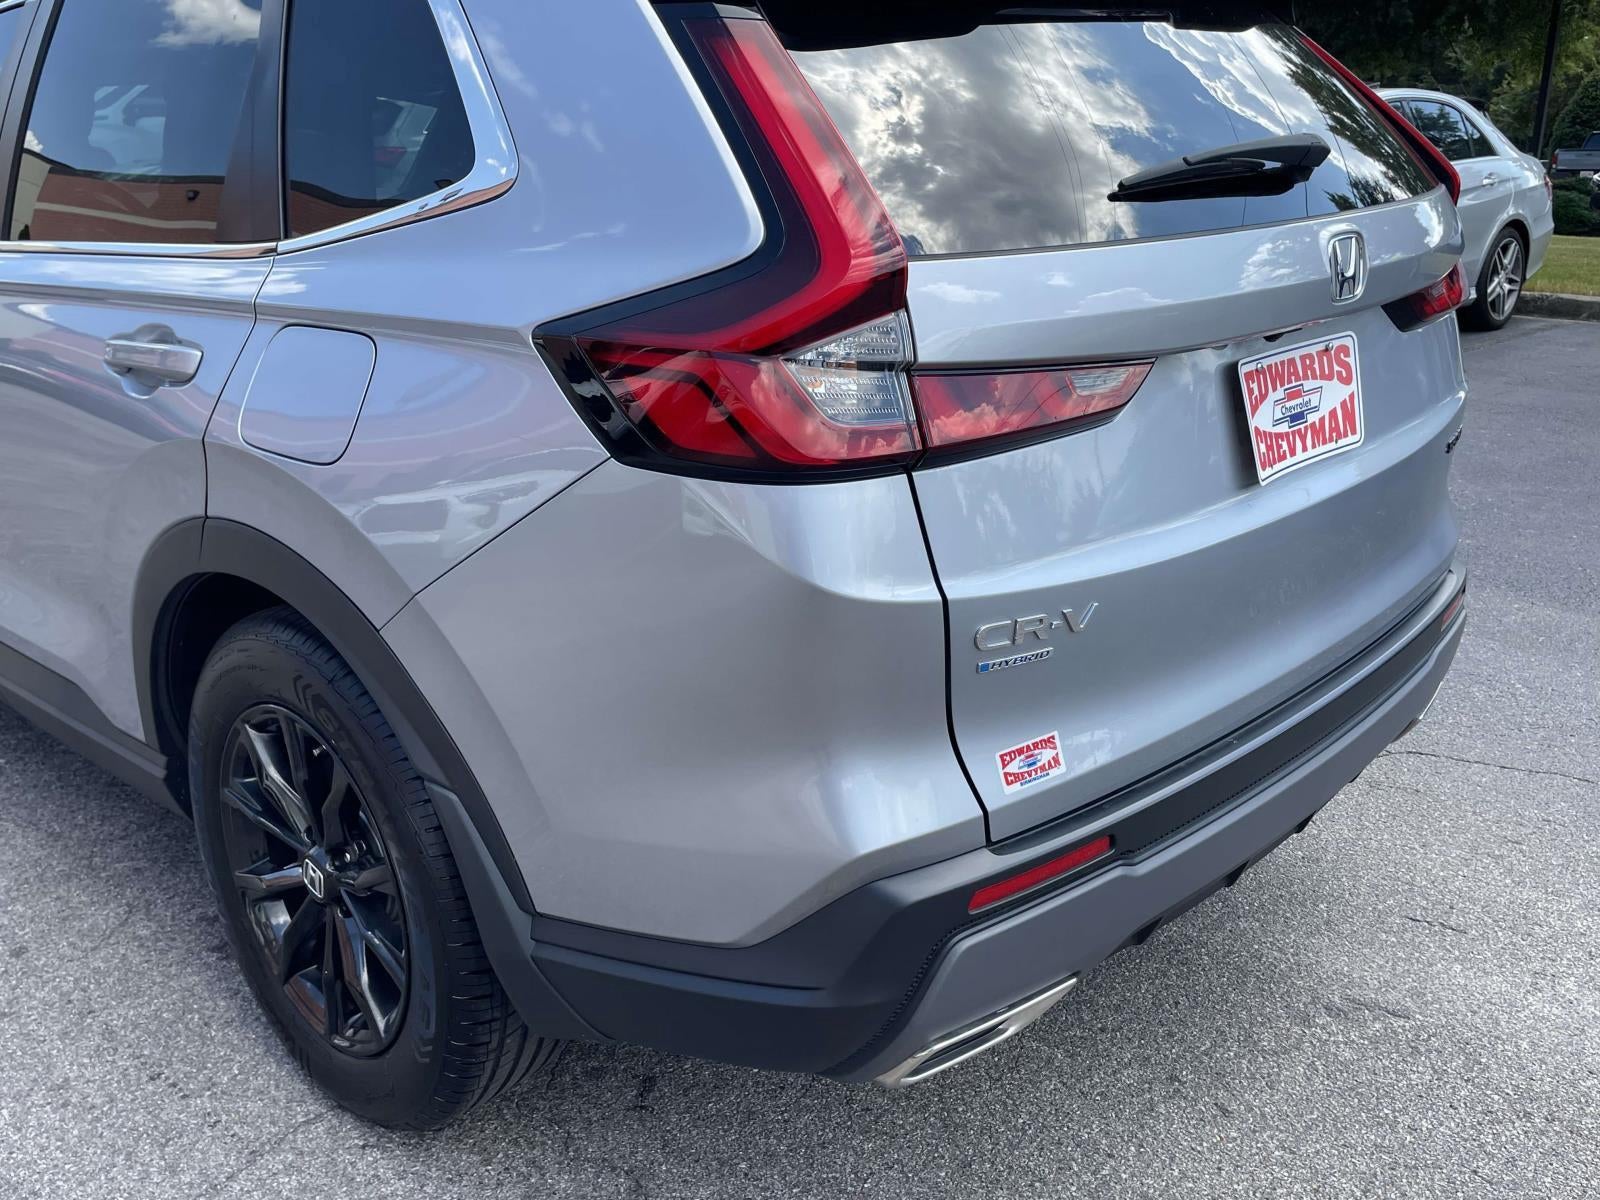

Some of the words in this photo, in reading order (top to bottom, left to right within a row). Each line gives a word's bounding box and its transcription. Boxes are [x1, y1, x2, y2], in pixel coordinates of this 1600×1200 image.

[1243, 344, 1354, 420] EDWARDS
[1280, 397, 1312, 415] Chevrolet
[1254, 391, 1358, 472] CHEVYMAN
[990, 650, 1051, 671] HYBRID
[999, 735, 1058, 770] EDWARDS
[1003, 751, 1062, 787] CHEVYMAN
